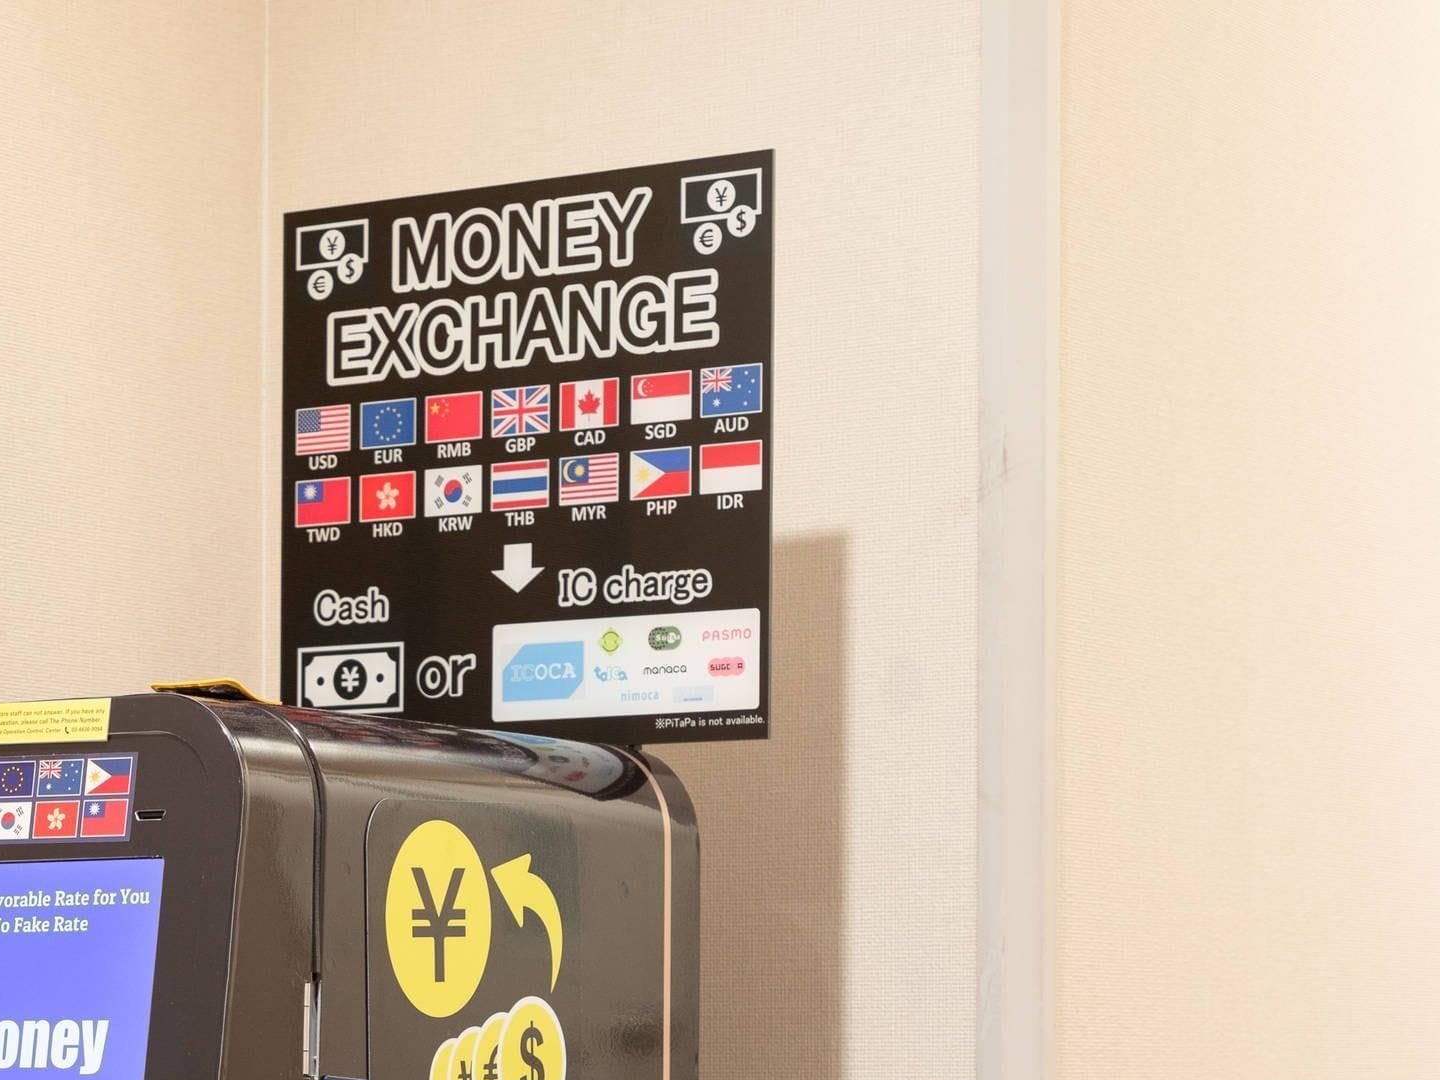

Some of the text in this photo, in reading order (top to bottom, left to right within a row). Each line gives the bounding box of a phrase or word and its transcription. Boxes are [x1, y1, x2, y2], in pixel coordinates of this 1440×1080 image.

[392, 186, 652, 293] MONEY
[326, 268, 719, 386] EXCHANGE
[645, 422, 677, 440] SGD
[714, 417, 749, 434] AUD
[506, 436, 536, 454] GBP
[574, 430, 606, 446] CAD
[374, 448, 403, 465] EUR
[437, 441, 471, 459] RMB
[308, 454, 338, 470] USD
[646, 500, 677, 516] PHP
[717, 494, 744, 510] IDR
[505, 511, 535, 527] THB
[571, 506, 607, 522] MYR
[372, 522, 403, 538] HKD
[438, 516, 473, 532] KRW
[306, 527, 340, 543] TWD
[558, 564, 712, 607] IC charge
[314, 586, 390, 626] Cash
[702, 628, 751, 642] PASMO
[416, 653, 476, 698] or
[510, 662, 577, 682] ICOCA
[643, 664, 687, 675] manaca
[621, 690, 659, 701] nimoca
[699, 717, 706, 726] is
[709, 717, 723, 726] not
[726, 714, 764, 725] available.
[54, 890, 89, 906] Rate
[93, 889, 117, 906] for
[120, 888, 150, 905] You
[14, 917, 50, 932] Fake
[53, 916, 88, 932] Rate
